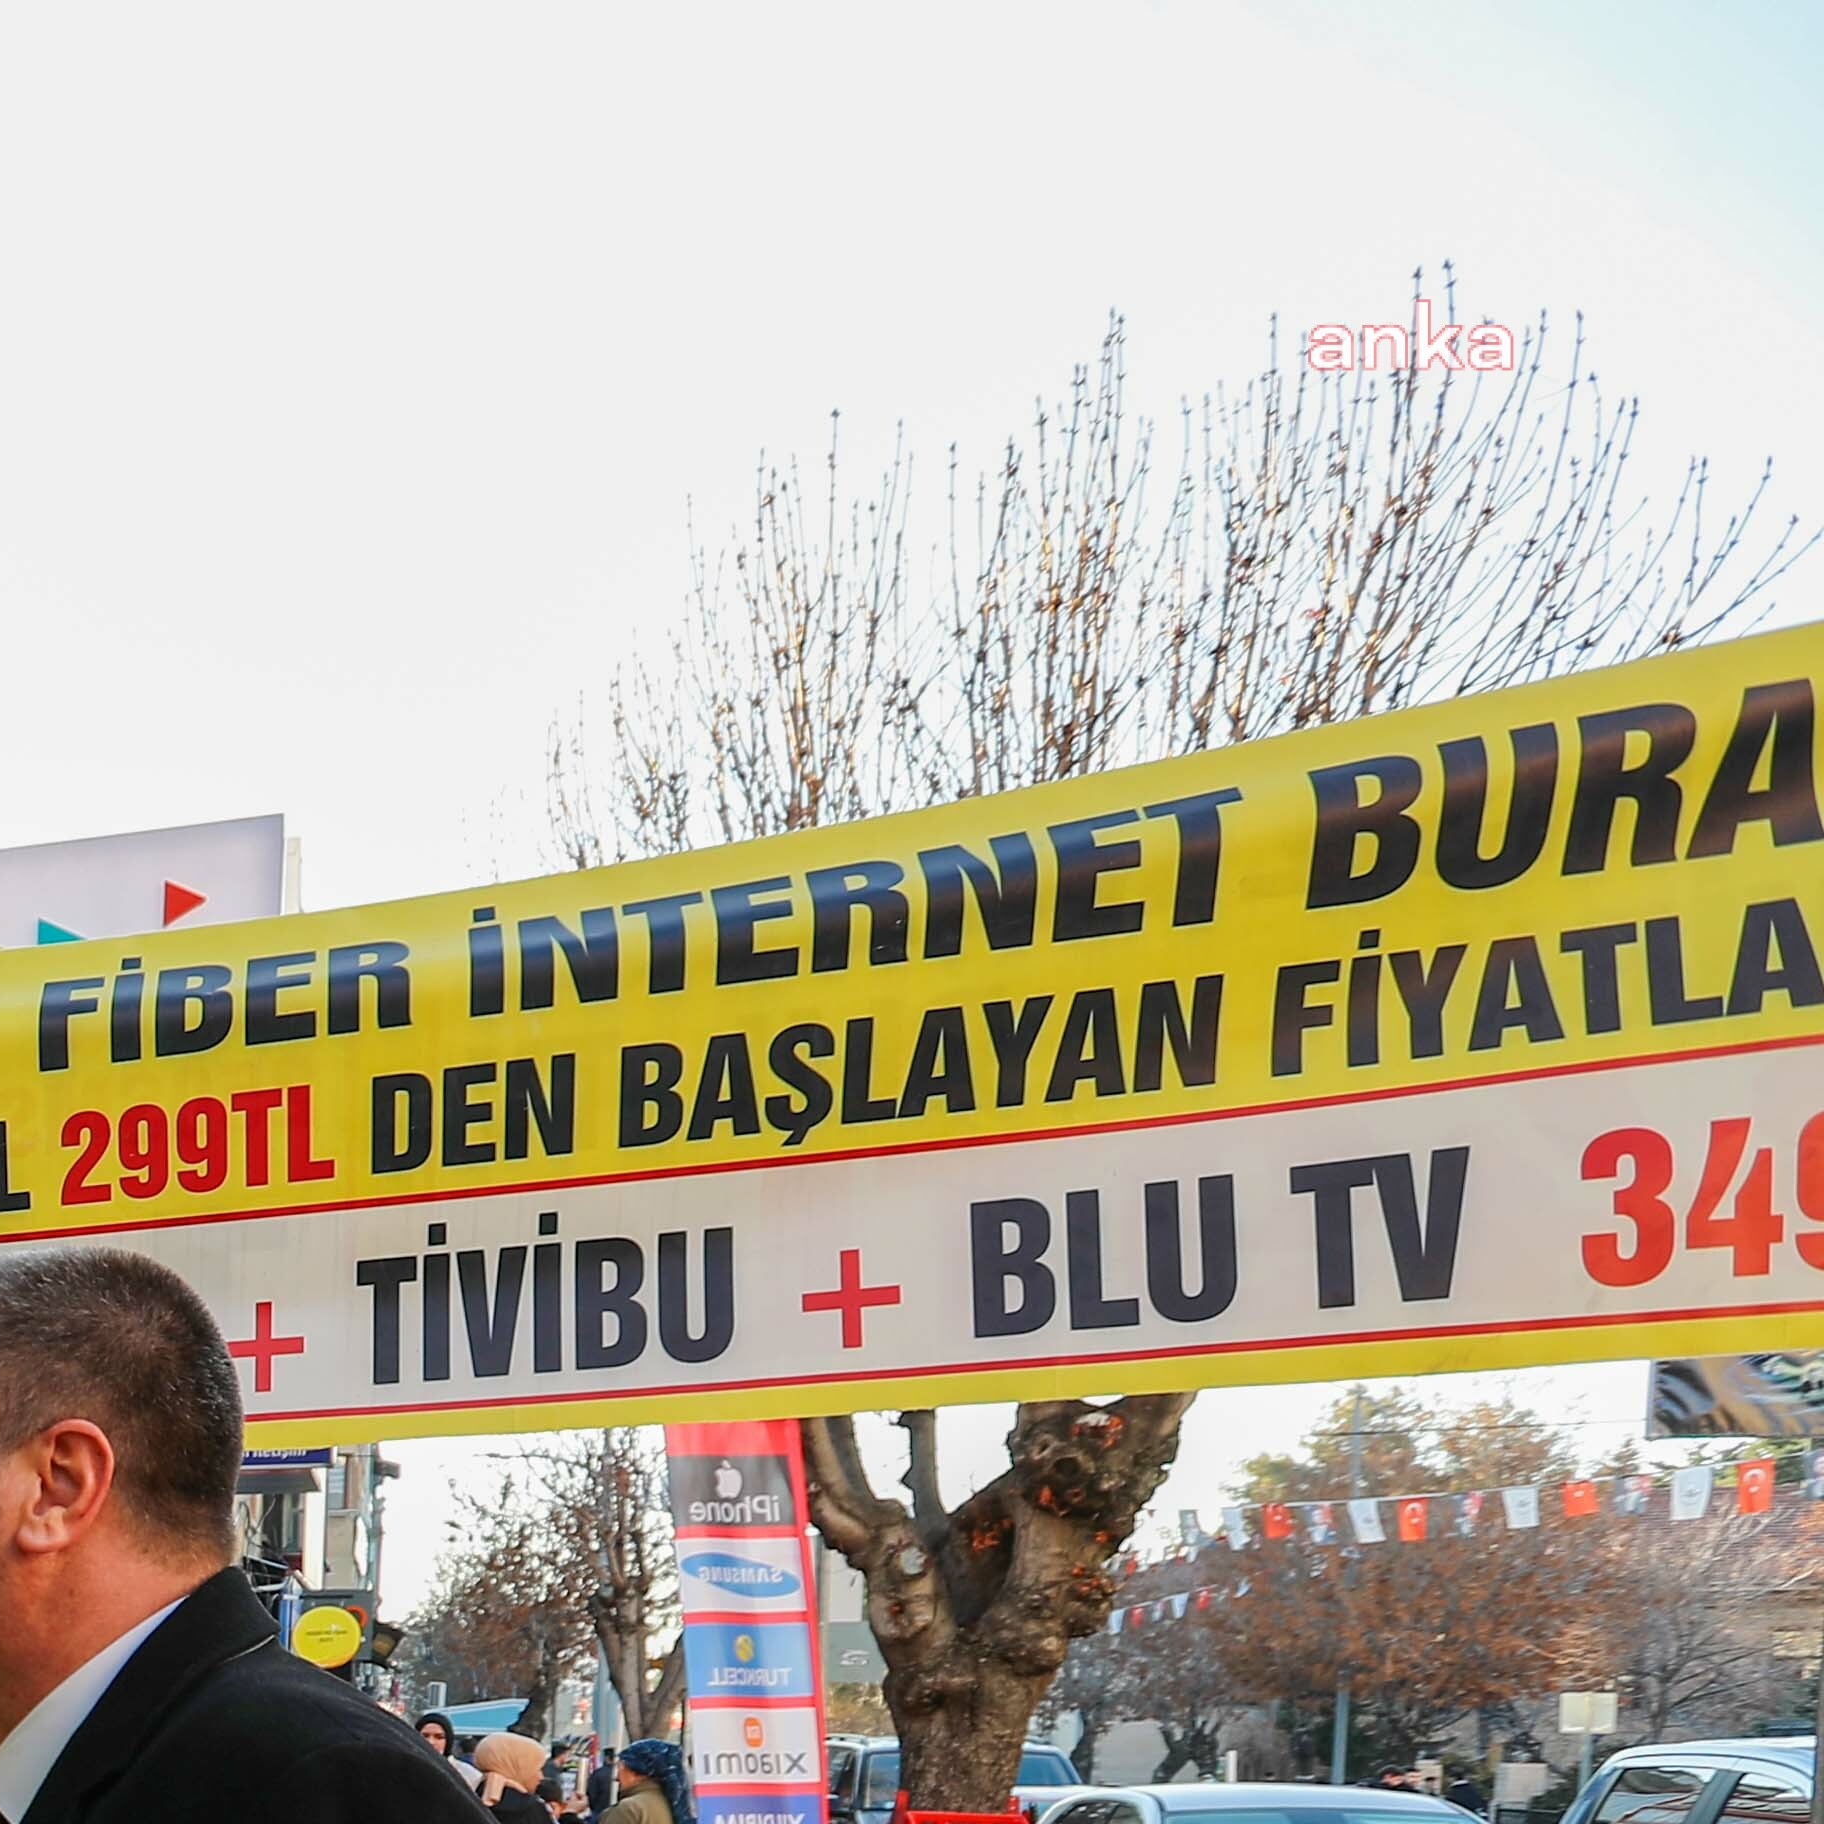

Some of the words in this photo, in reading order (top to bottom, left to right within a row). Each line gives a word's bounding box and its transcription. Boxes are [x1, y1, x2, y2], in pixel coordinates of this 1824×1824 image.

[38, 940, 413, 1073] FİBER
[467, 787, 1242, 1019] İNTERNET
[60, 1084, 336, 1207] 299TL
[370, 1052, 575, 1176] DEN
[617, 975, 1224, 1147] BAŞLAYAN
[355, 1211, 736, 1386] TİVİBU
[969, 1175, 1239, 1339] BLU
[1289, 1145, 1471, 1310] TV
